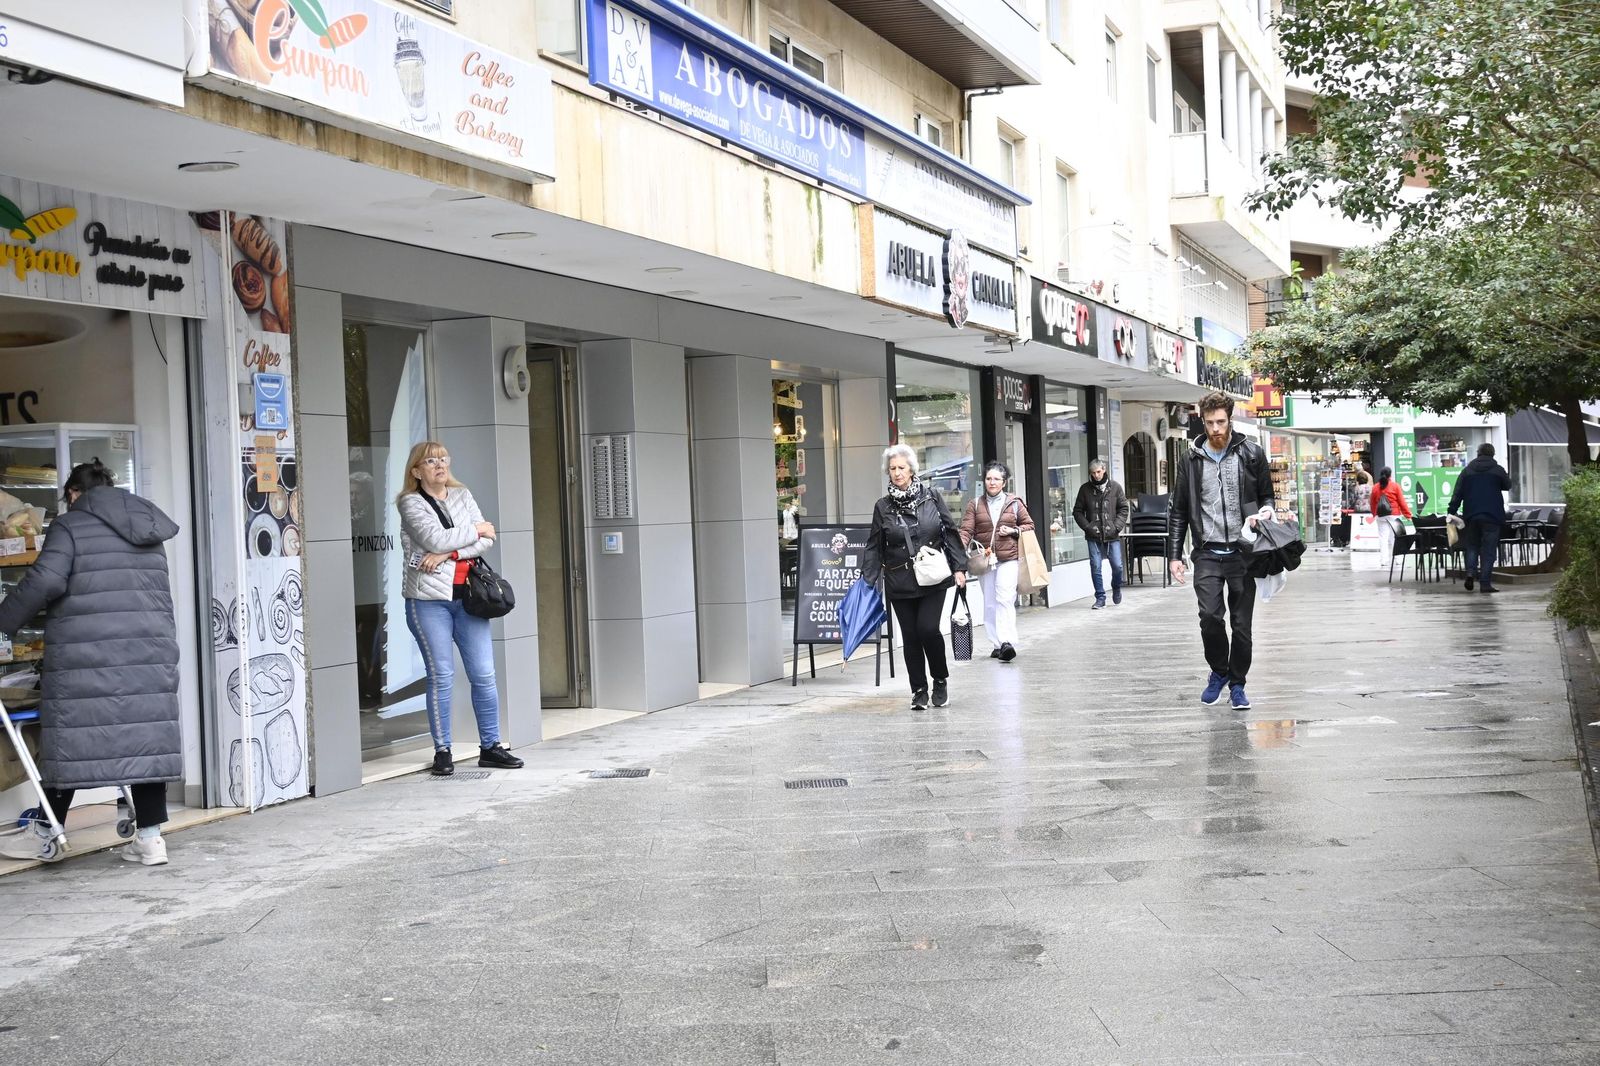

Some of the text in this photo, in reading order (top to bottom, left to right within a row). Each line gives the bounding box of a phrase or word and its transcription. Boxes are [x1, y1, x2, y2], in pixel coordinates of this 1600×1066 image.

[462, 51, 515, 89] Coffee
[468, 93, 508, 116] and
[674, 41, 851, 159] ABOGADOS
[455, 109, 524, 158] Bakery
[887, 240, 1015, 310] ABUELA CANALLA
[243, 339, 281, 373] Coffee
[503, 344, 531, 400] 6
[1397, 448, 1413, 459] 22h
[358, 531, 394, 552] PINZÓN
[817, 568, 862, 580] TARTAS
